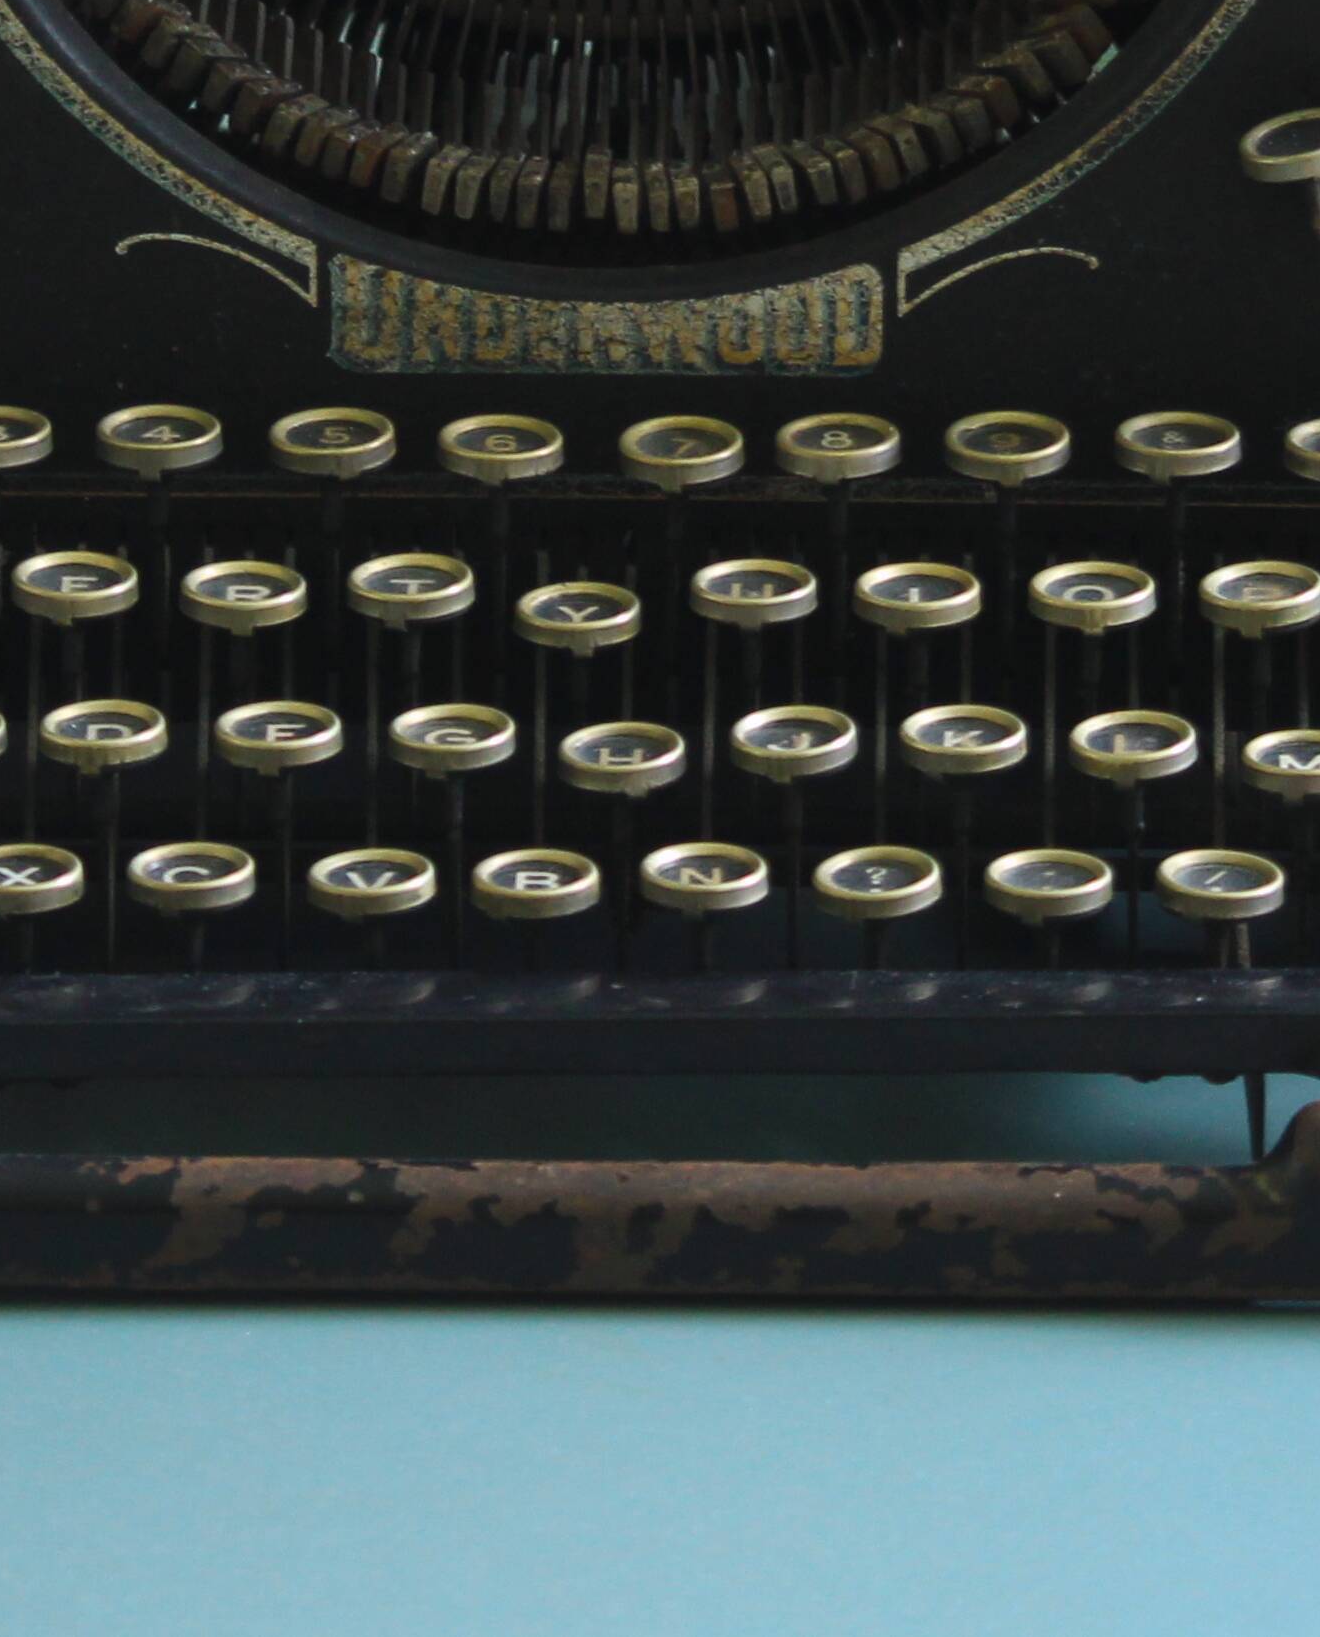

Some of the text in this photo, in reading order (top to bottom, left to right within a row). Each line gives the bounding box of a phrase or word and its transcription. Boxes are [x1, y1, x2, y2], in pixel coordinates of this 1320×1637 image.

[141, 425, 180, 443] 4
[318, 427, 351, 445] 5
[485, 435, 516, 452] 6
[821, 430, 852, 449] 8
[390, 578, 435, 595] T
[558, 606, 599, 623] Y
[598, 748, 643, 767] H
[943, 730, 985, 748] K
[346, 871, 397, 890] V
[514, 871, 559, 891] B
[679, 867, 722, 886] N
